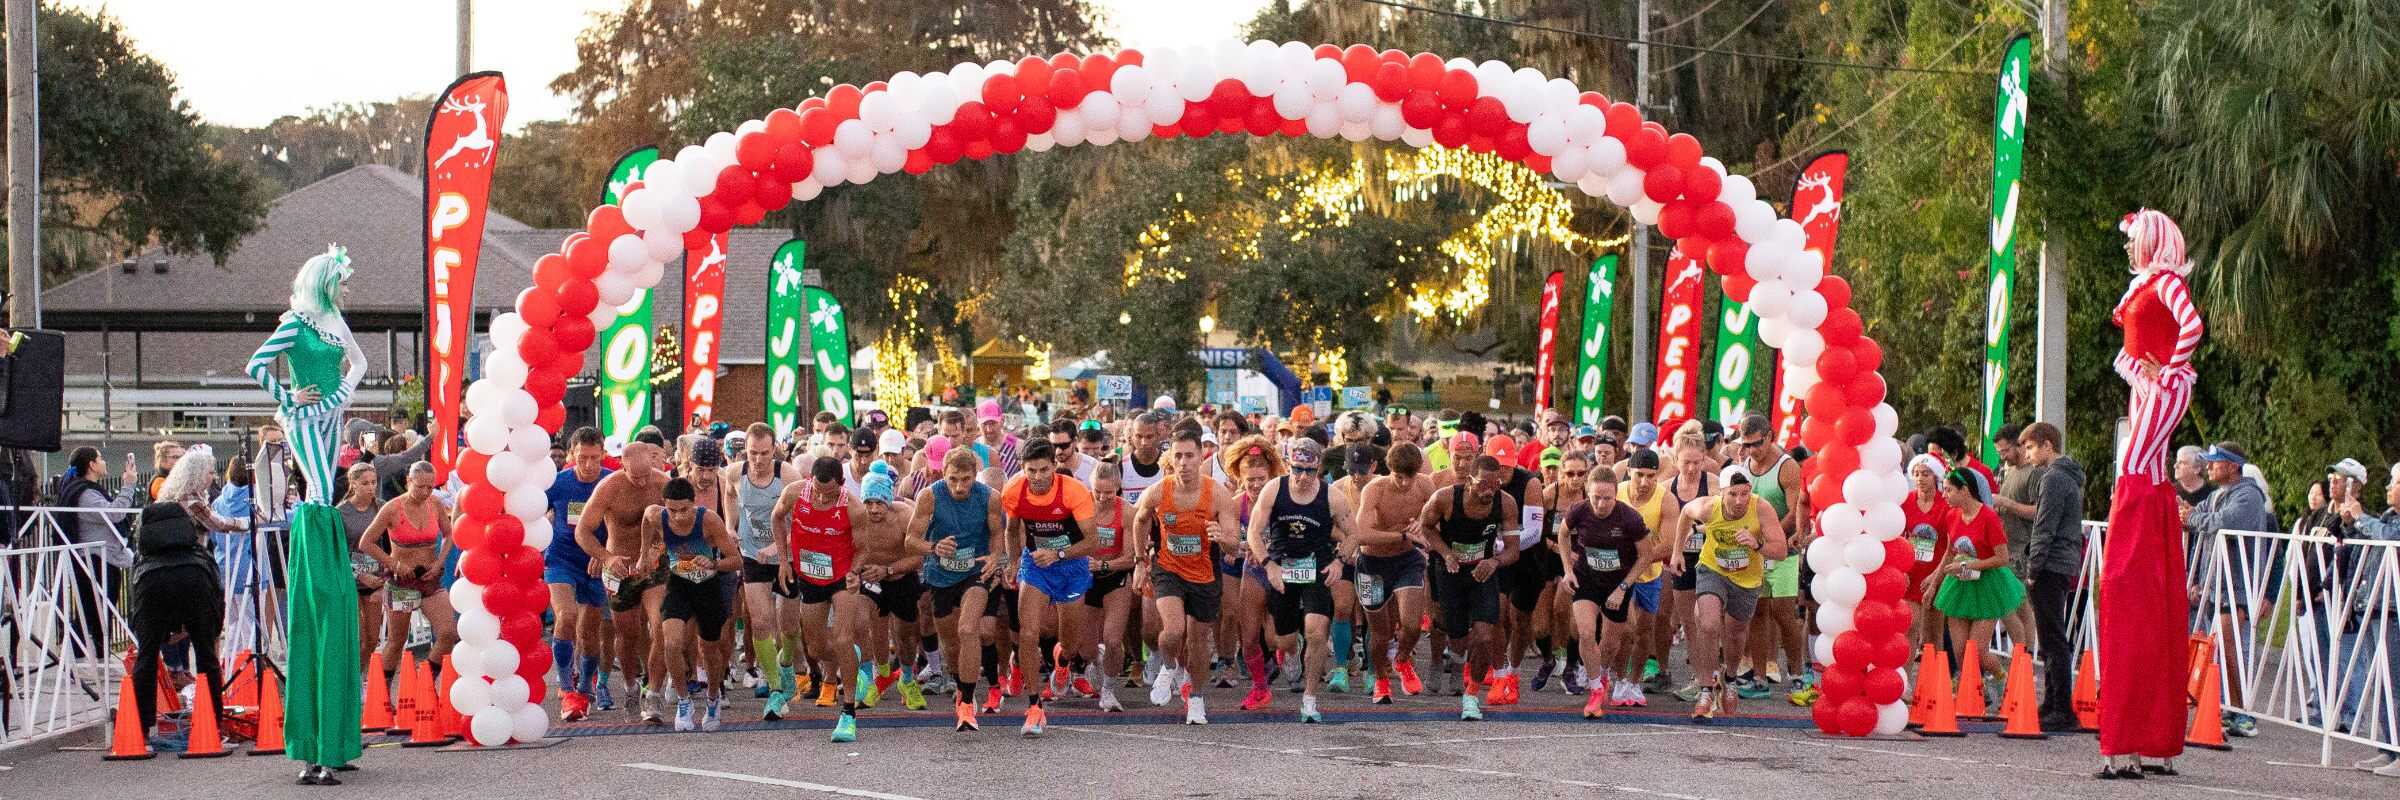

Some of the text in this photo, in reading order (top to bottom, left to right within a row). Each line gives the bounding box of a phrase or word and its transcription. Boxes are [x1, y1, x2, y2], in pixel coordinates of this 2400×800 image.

[1187, 351, 1251, 367] NISH
[1985, 179, 2020, 436] JOY
[771, 316, 797, 442] JOY
[1581, 321, 1606, 428] JOY
[1290, 569, 1310, 580] 1610
